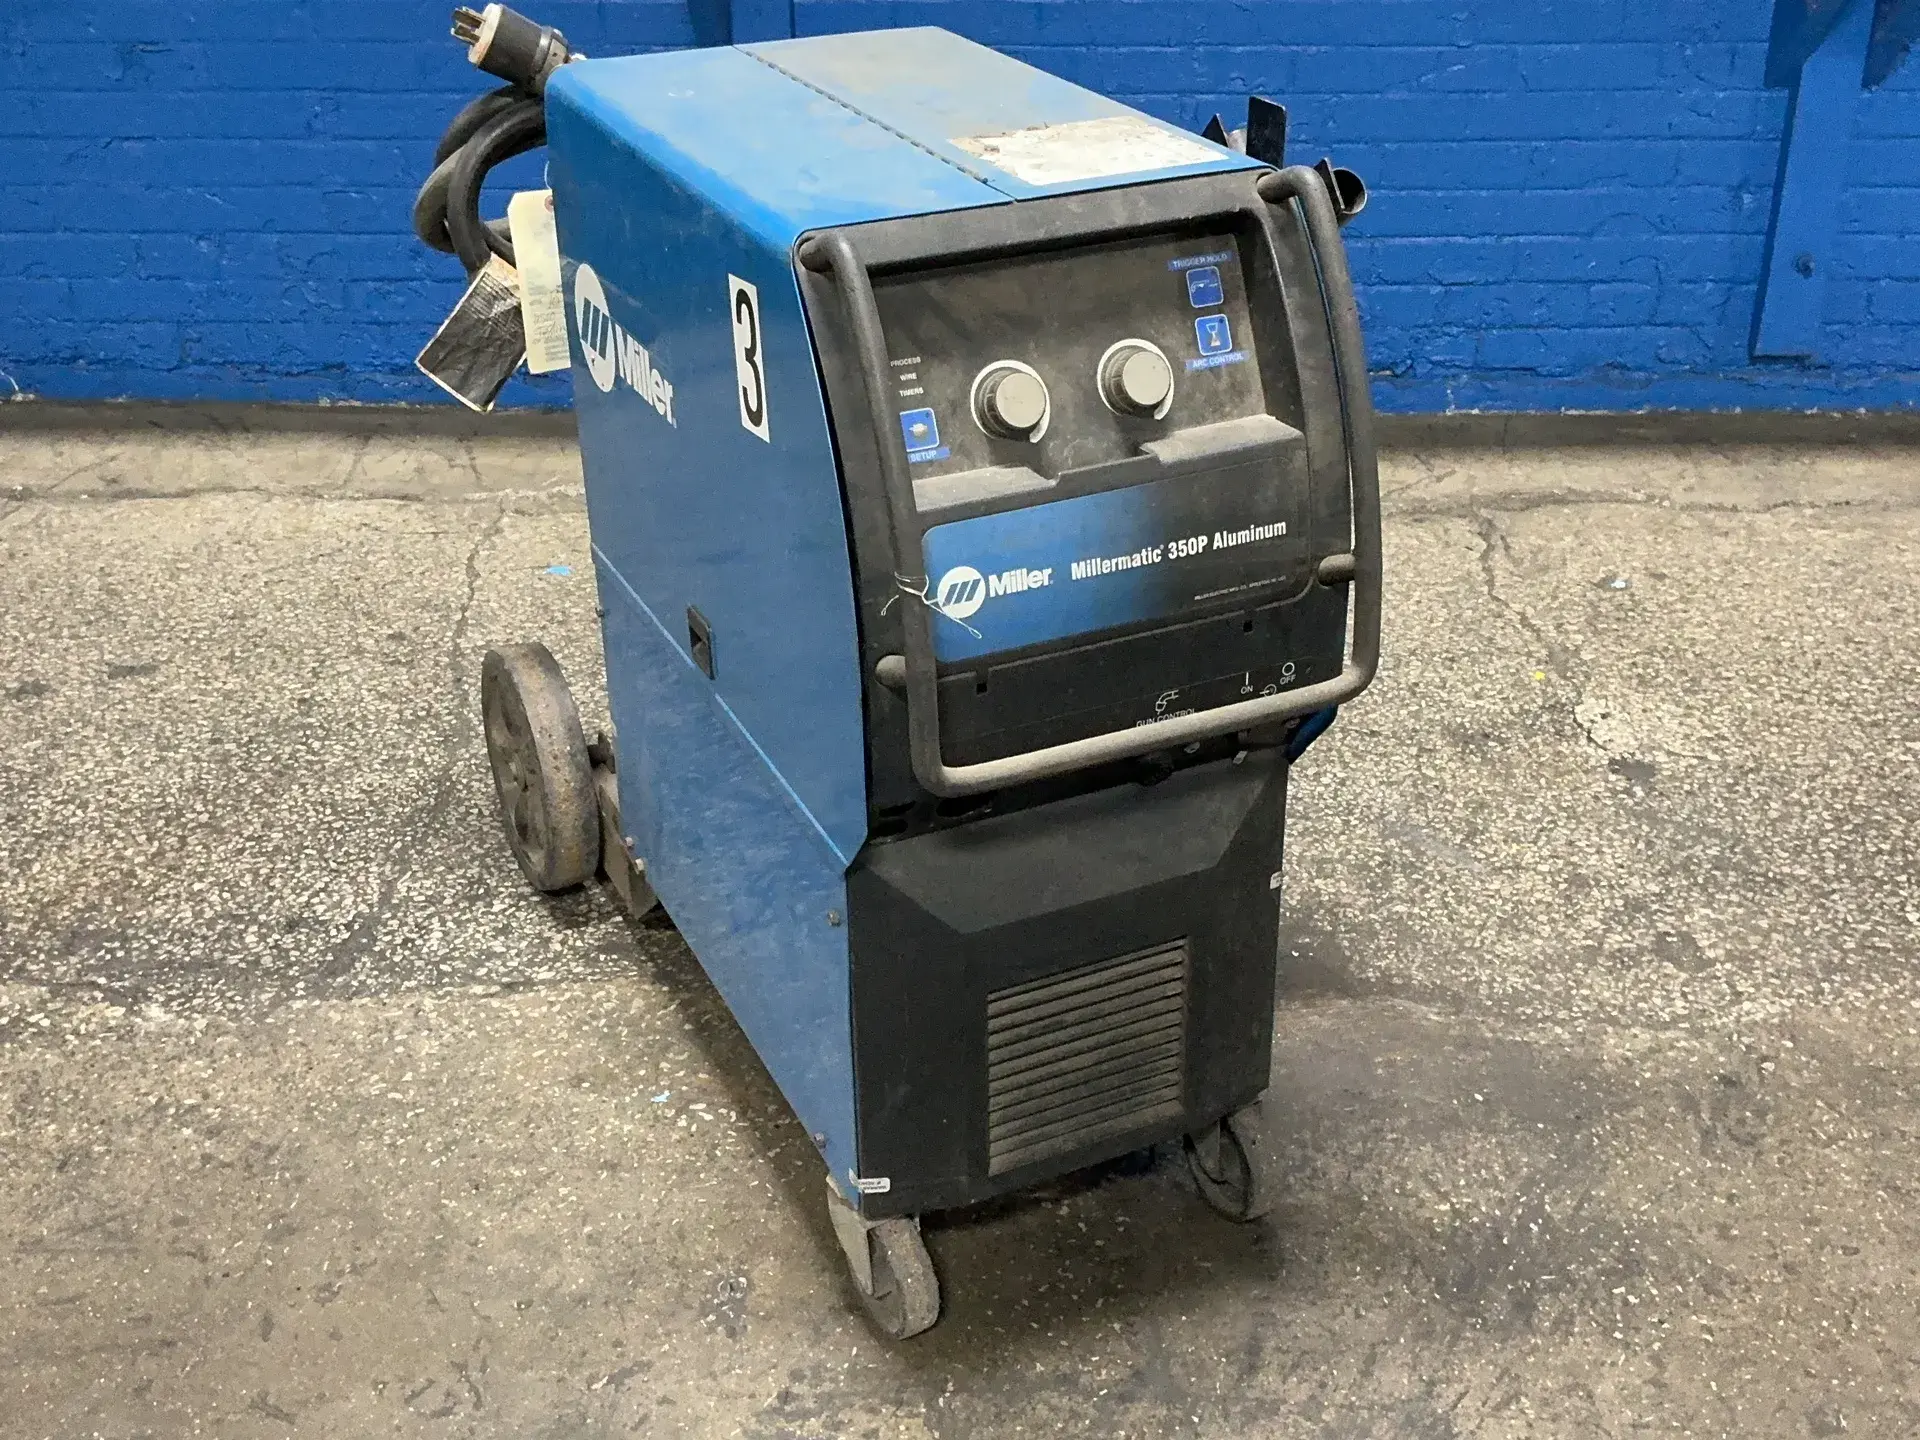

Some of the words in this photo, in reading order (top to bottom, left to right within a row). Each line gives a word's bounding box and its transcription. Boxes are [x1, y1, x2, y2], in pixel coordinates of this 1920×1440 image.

[736, 288, 763, 428] 3
[890, 356, 921, 367] PROCESS
[1193, 359, 1209, 368] ARC
[1209, 352, 1244, 366] CONTROL
[615, 323, 678, 429] Miller
[899, 372, 917, 381] WIRE
[899, 387, 924, 397] TIMERS
[910, 450, 937, 462] SETUP
[1168, 535, 1208, 560] 350P
[1212, 521, 1287, 550] Aluminum
[988, 567, 1053, 598] Miller
[1279, 674, 1297, 685] OFF
[1240, 685, 1253, 695] ON
